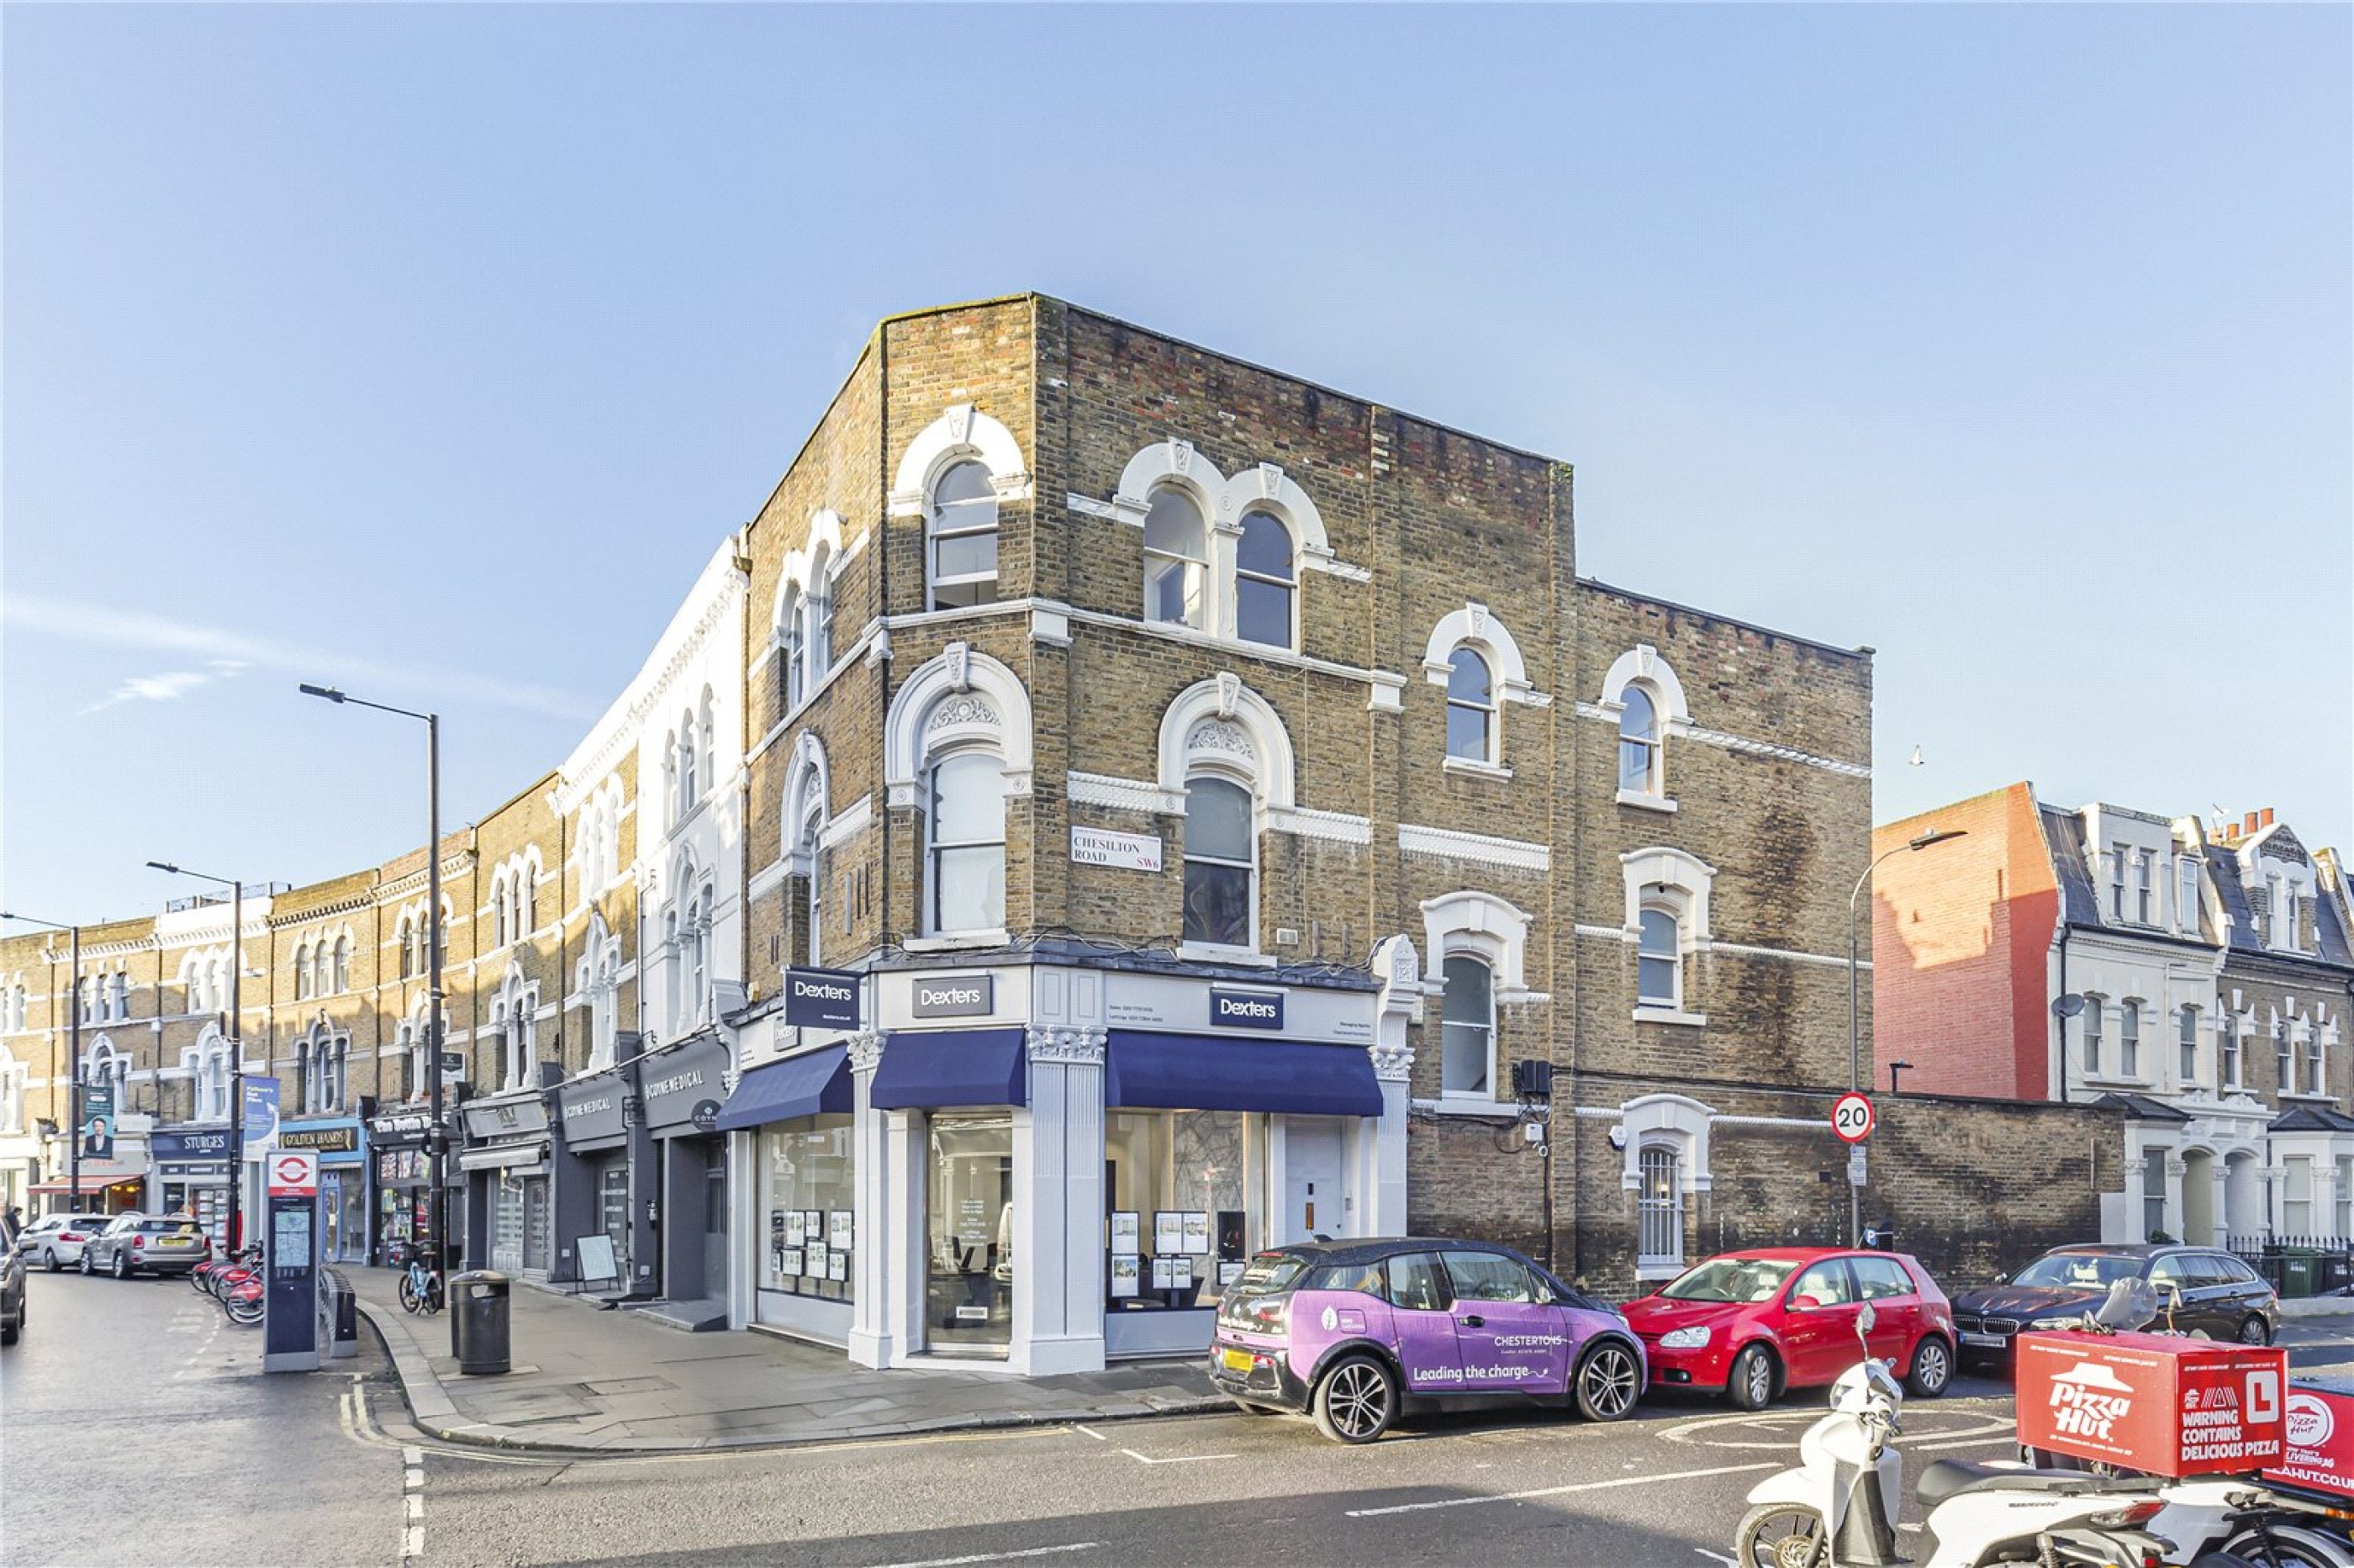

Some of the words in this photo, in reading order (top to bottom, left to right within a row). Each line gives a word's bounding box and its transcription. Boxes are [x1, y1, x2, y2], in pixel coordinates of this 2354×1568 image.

[1074, 837, 1139, 853] CHESILTON
[1074, 849, 1106, 862] ROAD
[1137, 858, 1159, 868] SW6
[795, 981, 852, 1001] Dexters
[921, 988, 981, 1006] Dexters
[1221, 998, 1275, 1018] Dexters
[1839, 1106, 1866, 1127] 20
[184, 1135, 224, 1149] STURGES
[287, 1132, 315, 1145] GOLDEN
[317, 1130, 344, 1143] HANDS
[1494, 1335, 1562, 1347] CHESTERTONS
[1413, 1366, 1462, 1382] Leading
[1465, 1365, 1486, 1378] the
[1488, 1364, 1528, 1381] charge
[2049, 1382, 2131, 1420] Pizza
[2254, 1382, 2271, 1412] L
[2054, 1407, 2114, 1439] Hut
[2182, 1409, 2239, 1427] WARNING
[2182, 1426, 2242, 1444] CONTAINS
[2290, 1425, 2314, 1435] Hut
[2182, 1442, 2244, 1461] DELICIOUS
[2245, 1439, 2279, 1456] PIZZA
[2286, 1450, 2322, 1464] LIVERING
